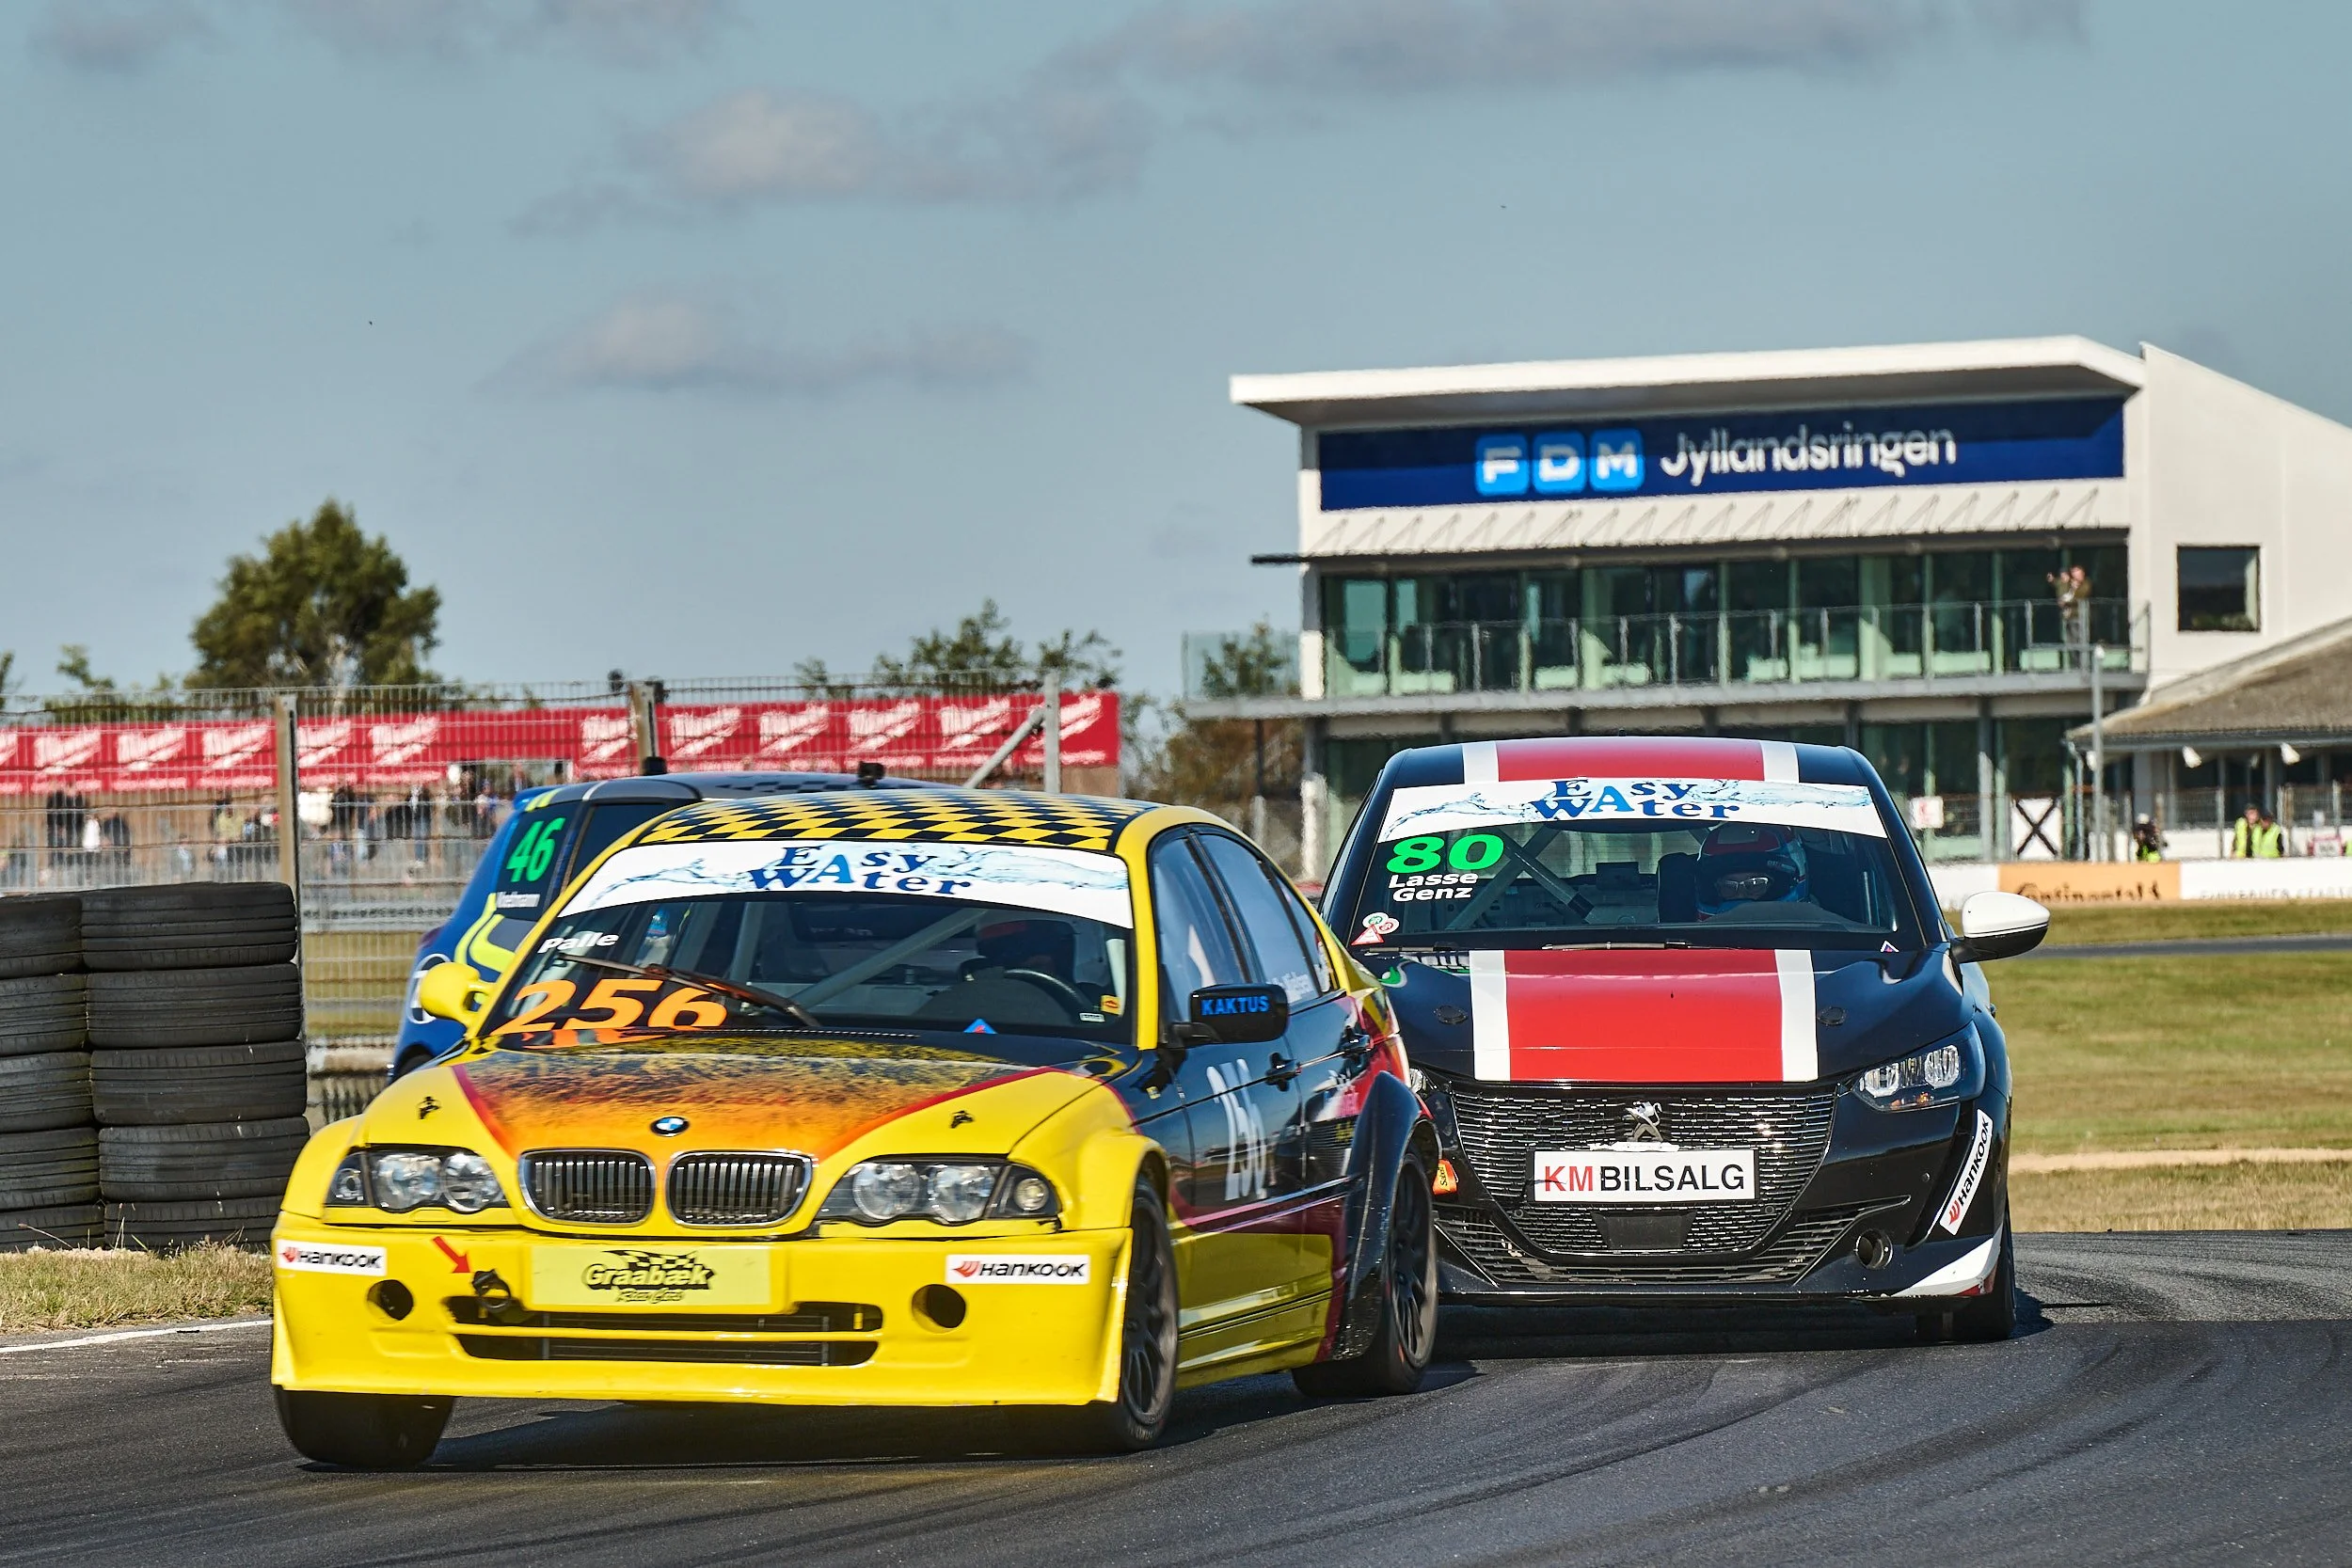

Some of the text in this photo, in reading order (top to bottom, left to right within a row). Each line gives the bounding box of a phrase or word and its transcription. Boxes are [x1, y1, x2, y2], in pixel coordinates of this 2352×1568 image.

[1483, 421, 1958, 486] FDM Jyllandsringen
[506, 816, 566, 883] 46
[1386, 833, 1504, 874] 80
[1388, 873, 1479, 889] Lasse
[1392, 887, 1473, 902] Genz
[537, 931, 619, 954] Palle
[489, 978, 728, 1036] 256
[1200, 995, 1270, 1016] KAKTUS
[582, 1262, 715, 1290] Graabæk
